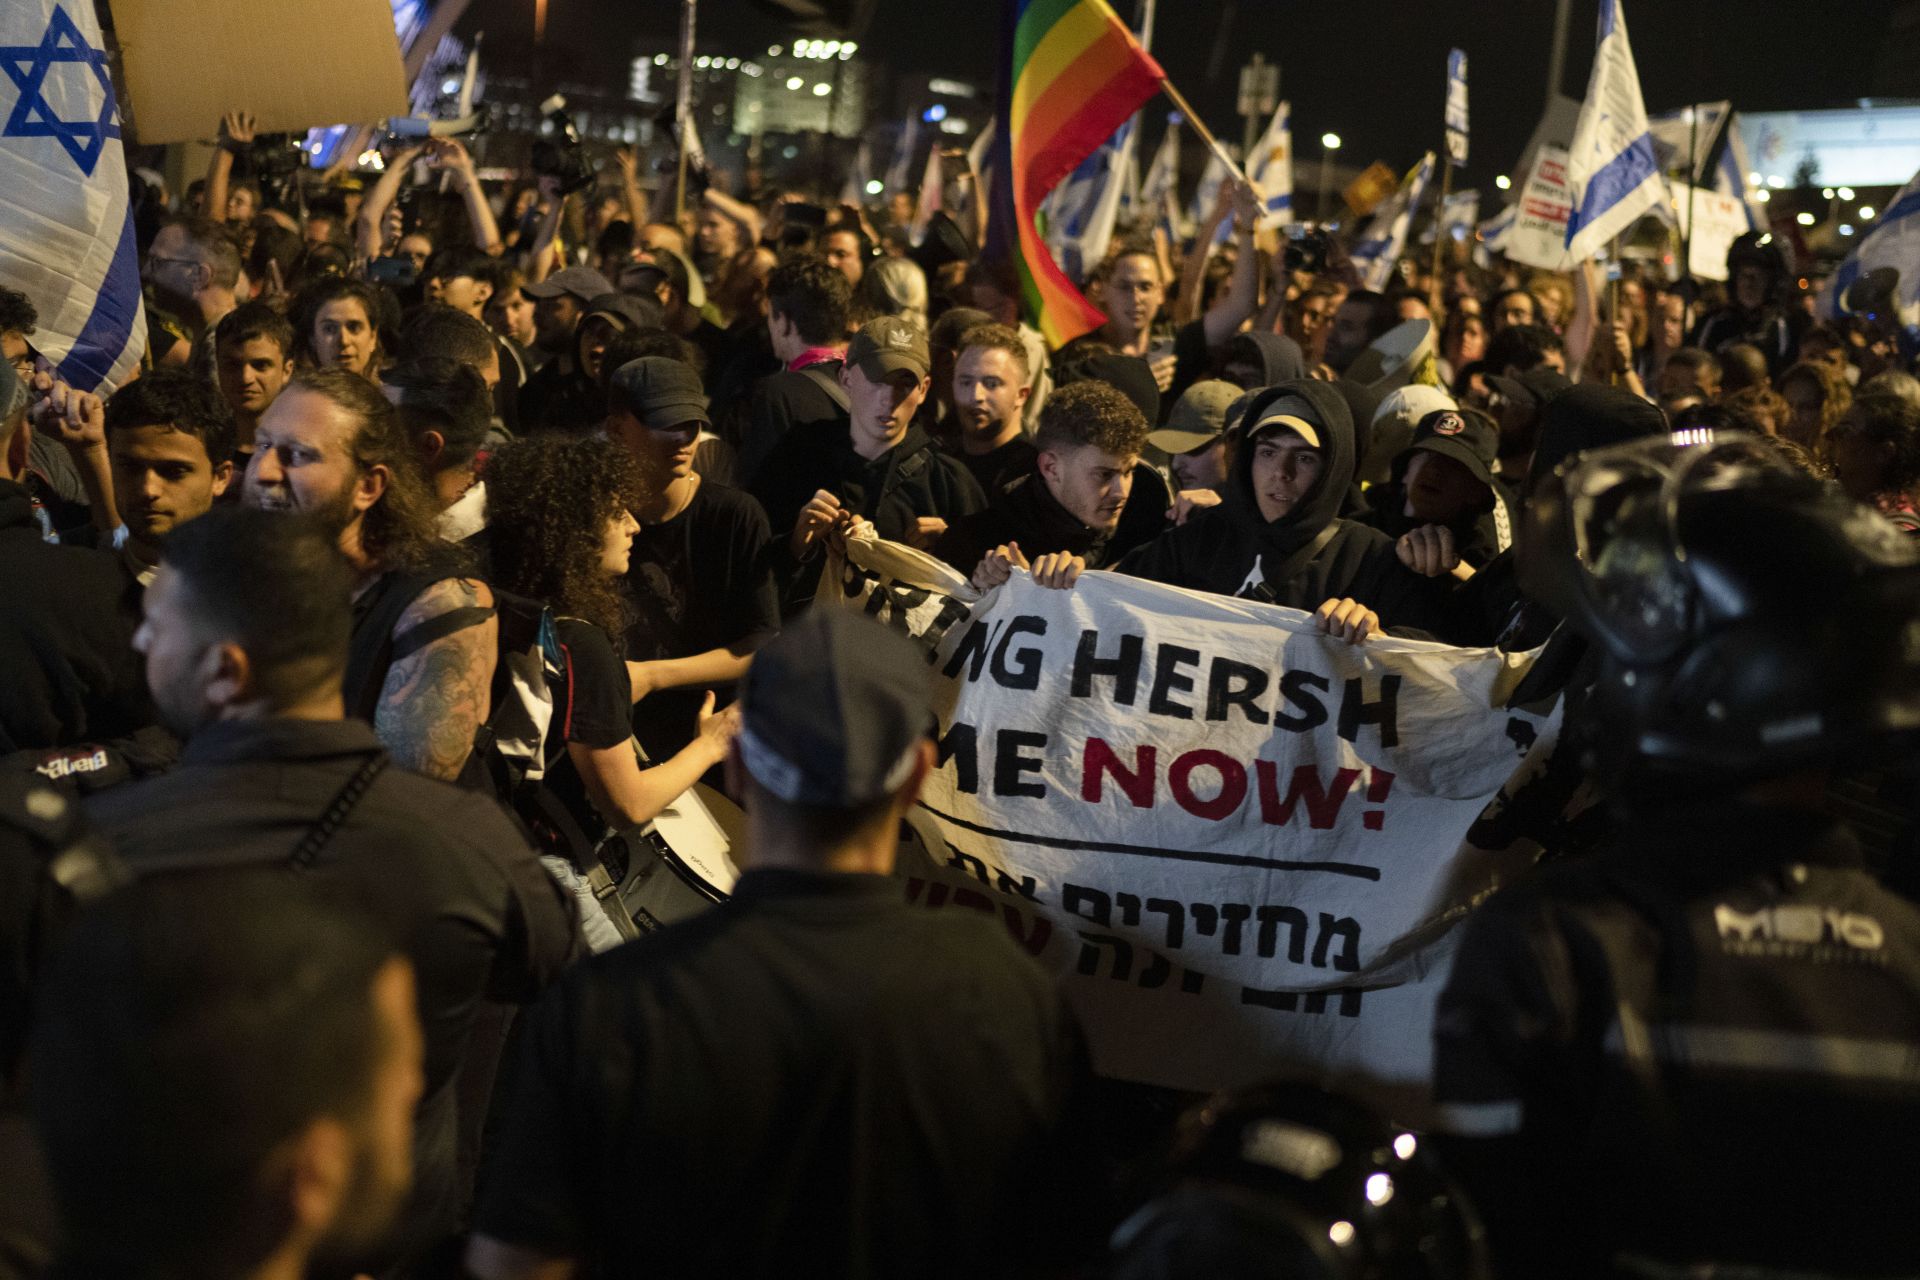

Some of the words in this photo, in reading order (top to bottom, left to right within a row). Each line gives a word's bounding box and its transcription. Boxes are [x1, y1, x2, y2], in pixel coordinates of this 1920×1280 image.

[1070, 628, 1402, 749] HERSH
[1081, 736, 1396, 832] NOW!
[1062, 882, 1362, 973] מחזירים
